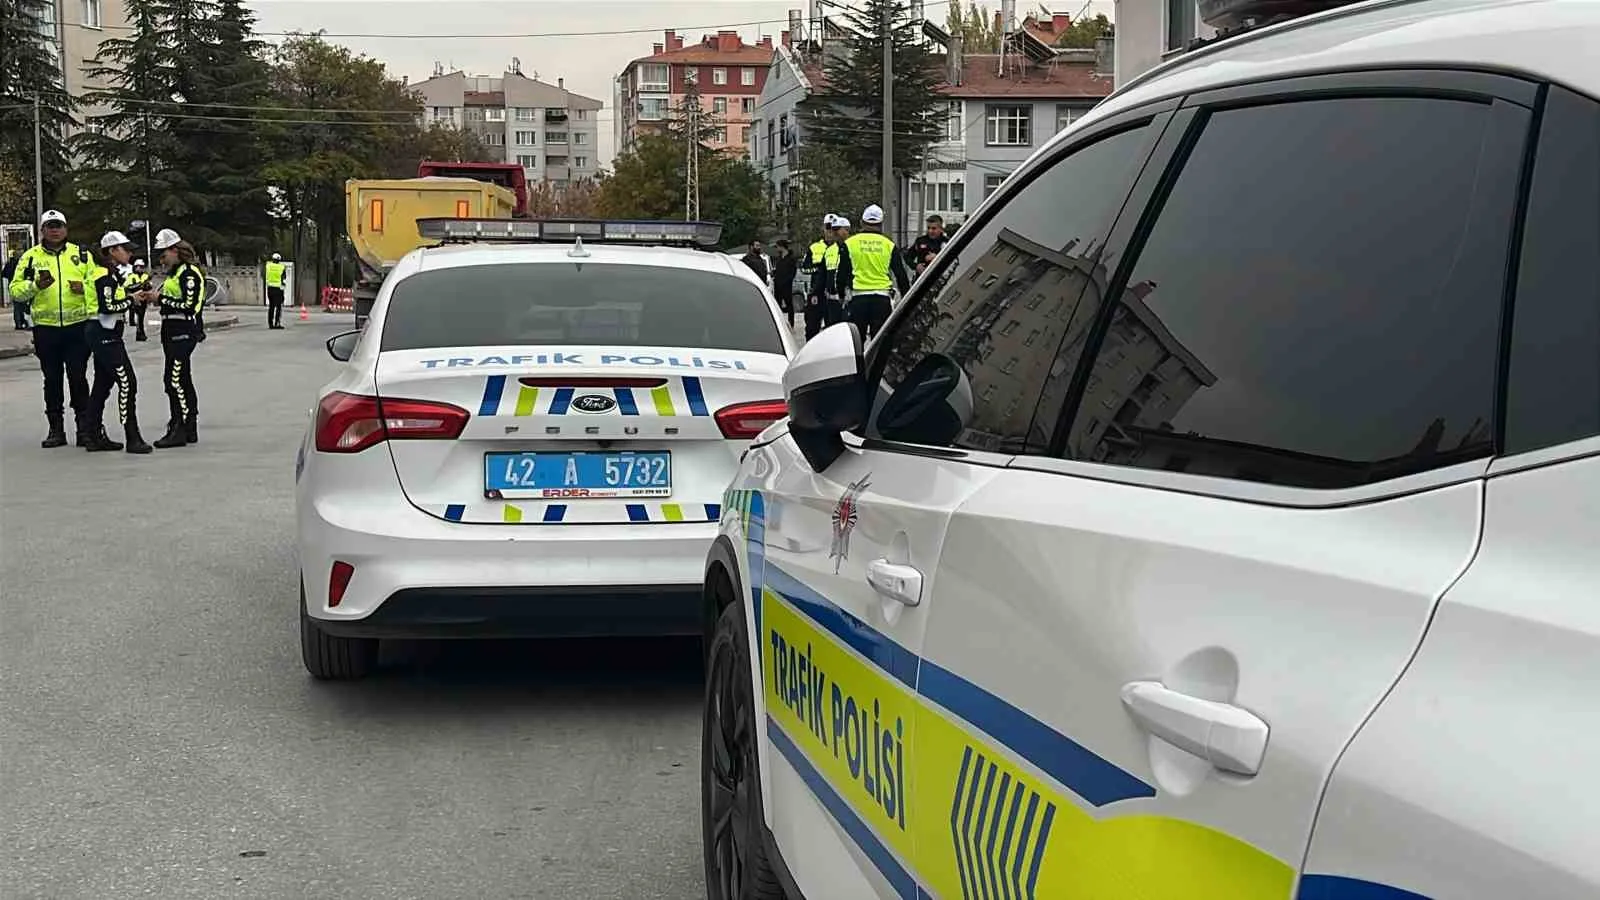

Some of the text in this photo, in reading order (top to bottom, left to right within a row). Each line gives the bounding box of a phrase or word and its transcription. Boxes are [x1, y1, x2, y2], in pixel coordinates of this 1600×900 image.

[504, 456, 667, 486] 42 A 5732
[542, 489, 590, 497] ERDER
[771, 629, 905, 832] TRAFİK POLİSİ
